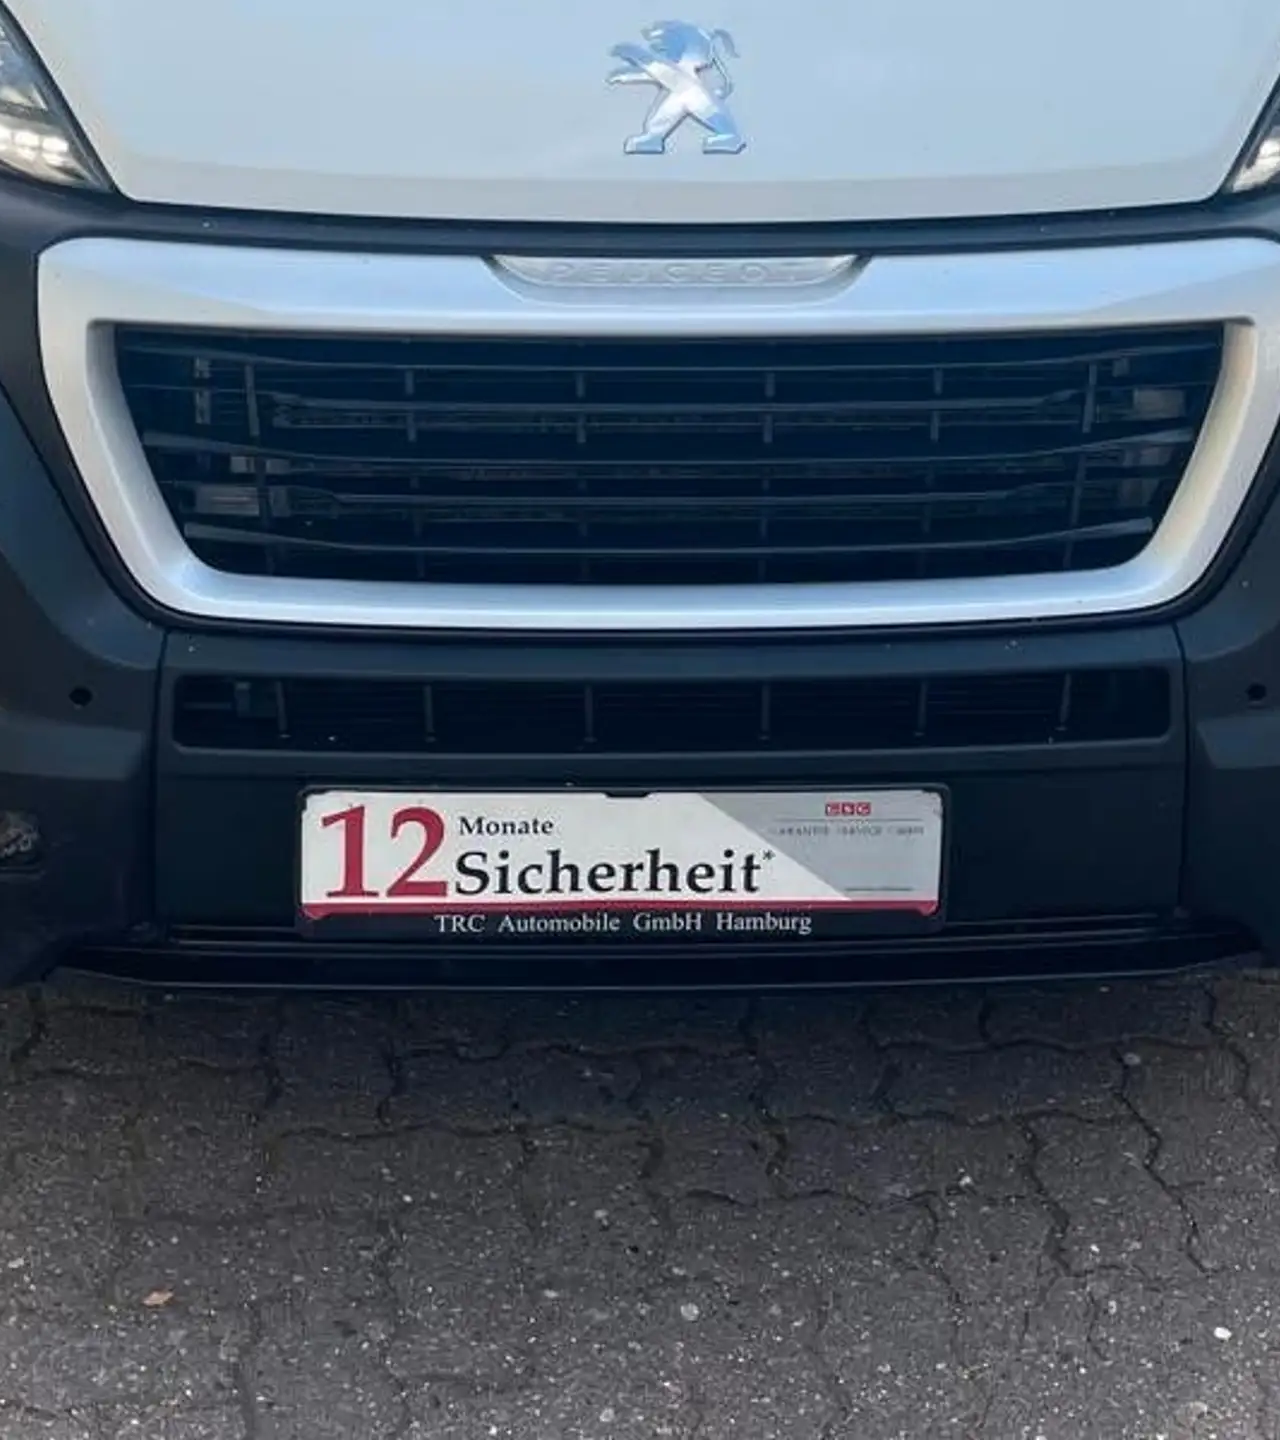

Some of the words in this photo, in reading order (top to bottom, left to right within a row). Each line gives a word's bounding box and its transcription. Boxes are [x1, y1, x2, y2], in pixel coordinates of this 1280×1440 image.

[459, 816, 554, 836] Monate
[321, 805, 448, 897] 12
[434, 914, 485, 933] TRC
[498, 912, 620, 933] Automobile
[632, 912, 702, 932] GmbH
[716, 911, 812, 935] Hamburg
